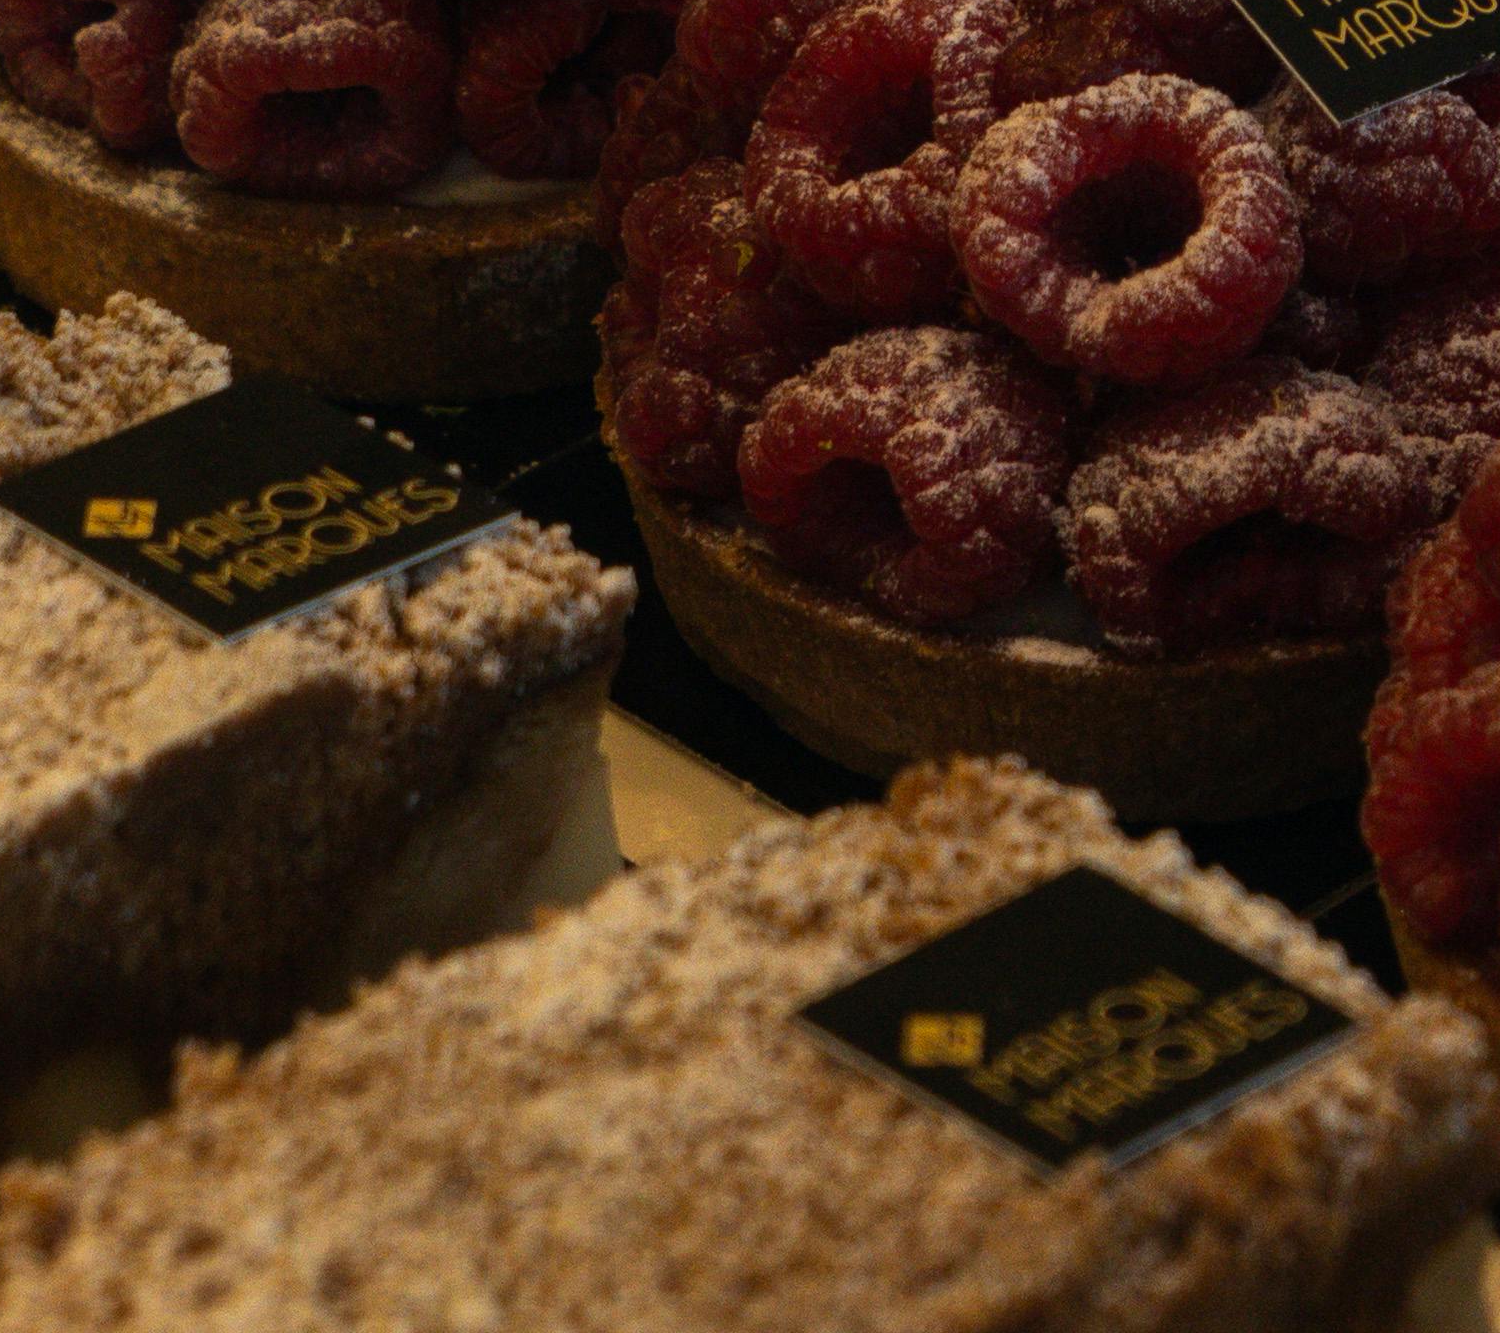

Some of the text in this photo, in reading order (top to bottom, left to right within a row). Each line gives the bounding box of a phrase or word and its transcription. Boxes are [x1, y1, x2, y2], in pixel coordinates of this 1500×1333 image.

[138, 465, 362, 573] MAISON
[189, 478, 461, 605] MARQUES
[966, 967, 1204, 1106] MAISON
[1023, 980, 1309, 1143] MARQUES
